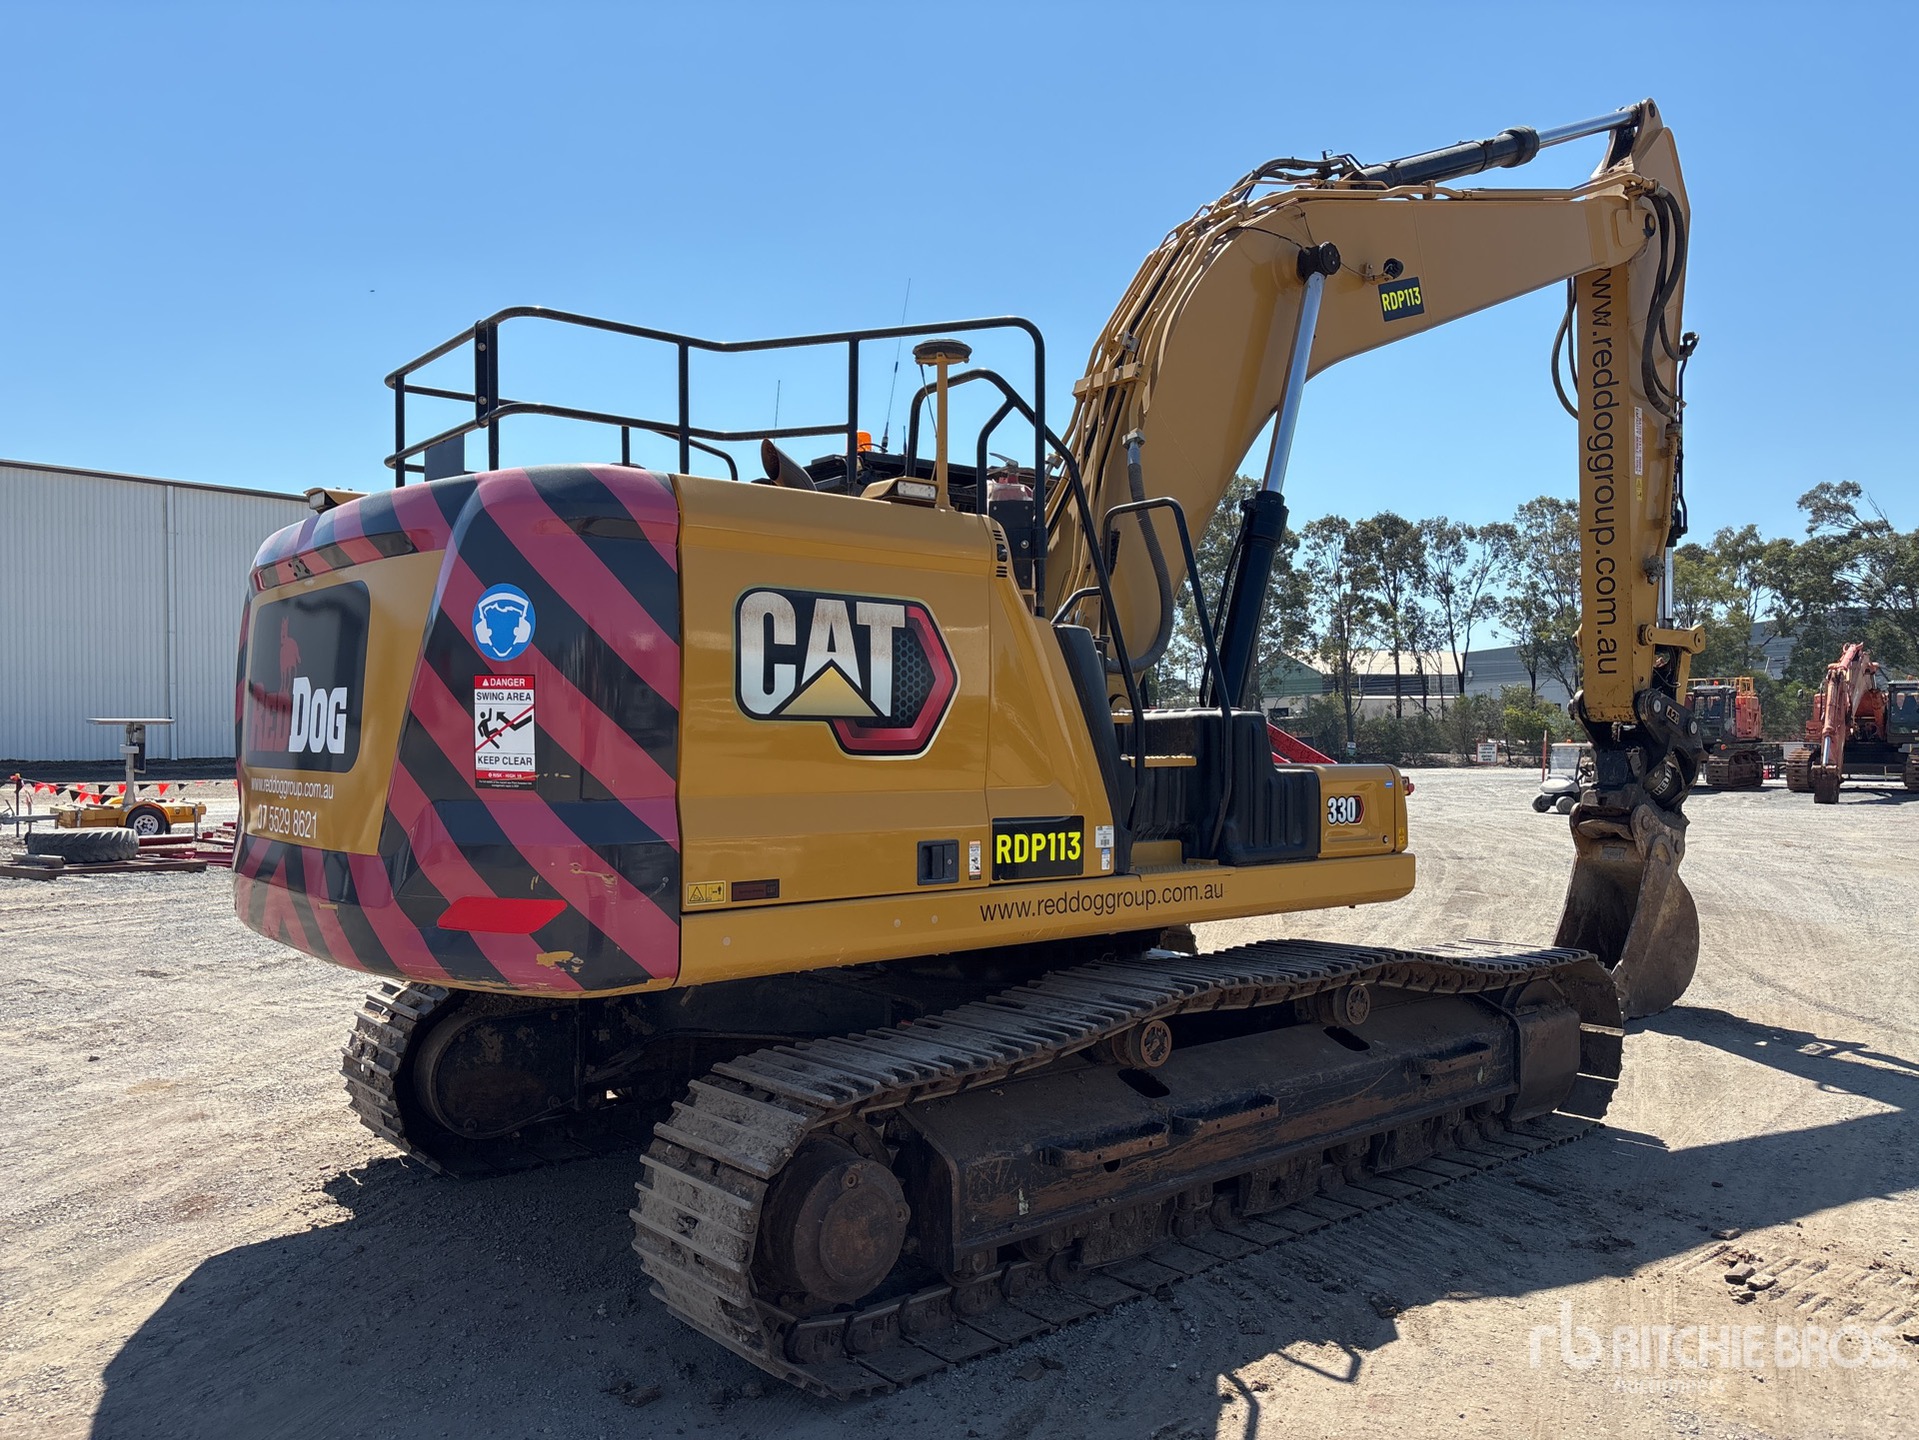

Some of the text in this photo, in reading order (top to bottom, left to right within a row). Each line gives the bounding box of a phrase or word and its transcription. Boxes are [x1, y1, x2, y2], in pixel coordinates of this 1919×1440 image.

[1381, 286, 1421, 311] RDP113
[1587, 268, 1619, 674] ww.reddoggroup.com.au
[740, 591, 906, 717] CAT
[476, 692, 532, 701] SWING AREA
[490, 678, 525, 687] DANGER
[251, 676, 348, 754] RED DOG
[477, 755, 533, 766] KEEP CLEAR
[252, 775, 334, 800] www.reddoggroup.com.au
[257, 803, 318, 839] 07 5529 8621
[1327, 796, 1356, 824] 330
[996, 831, 1082, 864] RDP113
[980, 882, 1223, 922] www.reddoggroup.com.au
